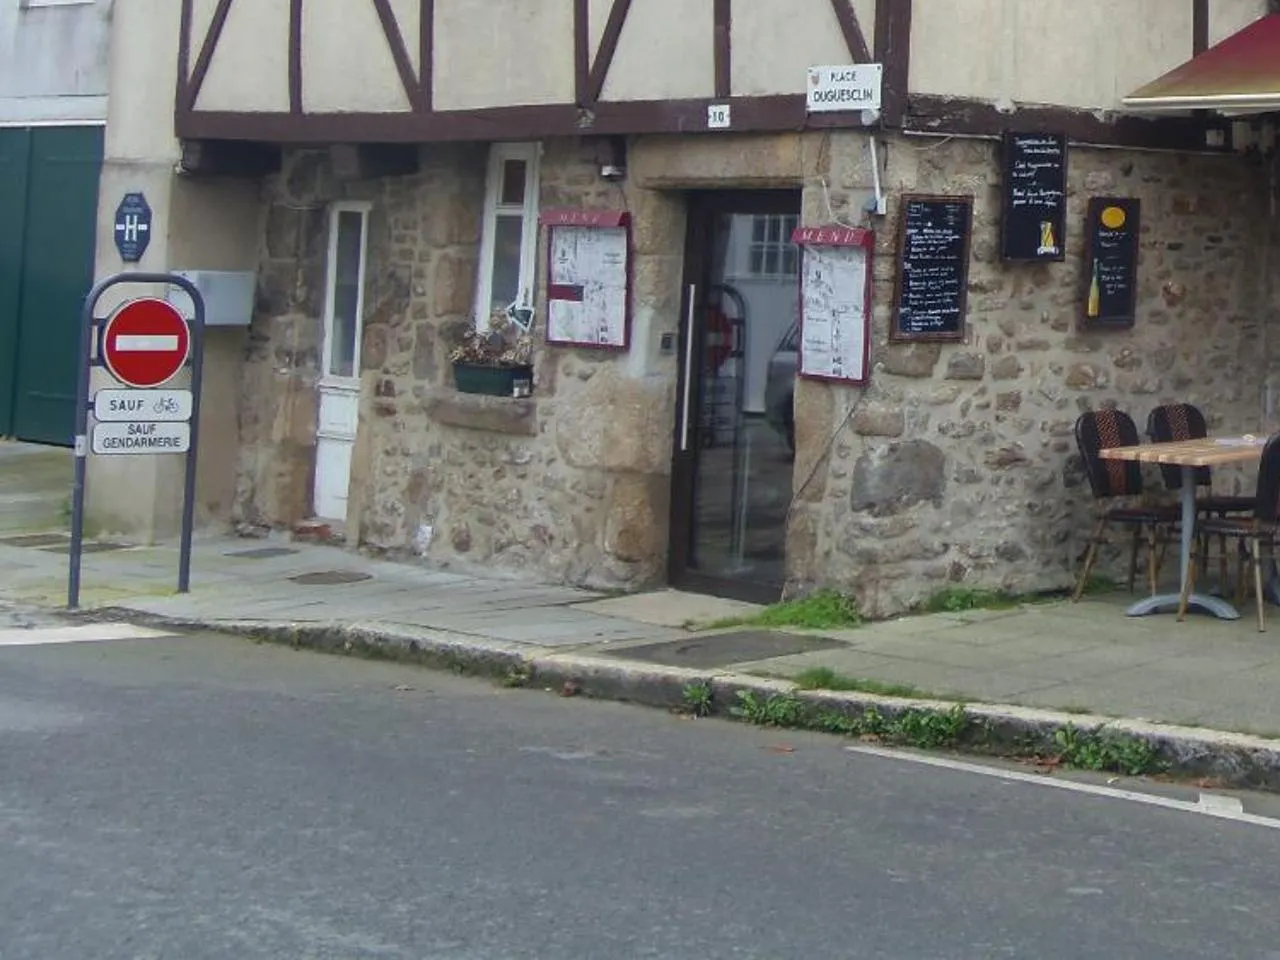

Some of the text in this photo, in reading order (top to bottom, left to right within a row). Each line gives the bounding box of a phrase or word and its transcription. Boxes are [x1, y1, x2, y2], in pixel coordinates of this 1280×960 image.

[830, 71, 858, 83] PLACE
[813, 88, 873, 104] DUGUESCLIN
[110, 399, 145, 412] SAUF
[128, 423, 157, 435] SAUF
[102, 436, 182, 449] GENDARMERIE
